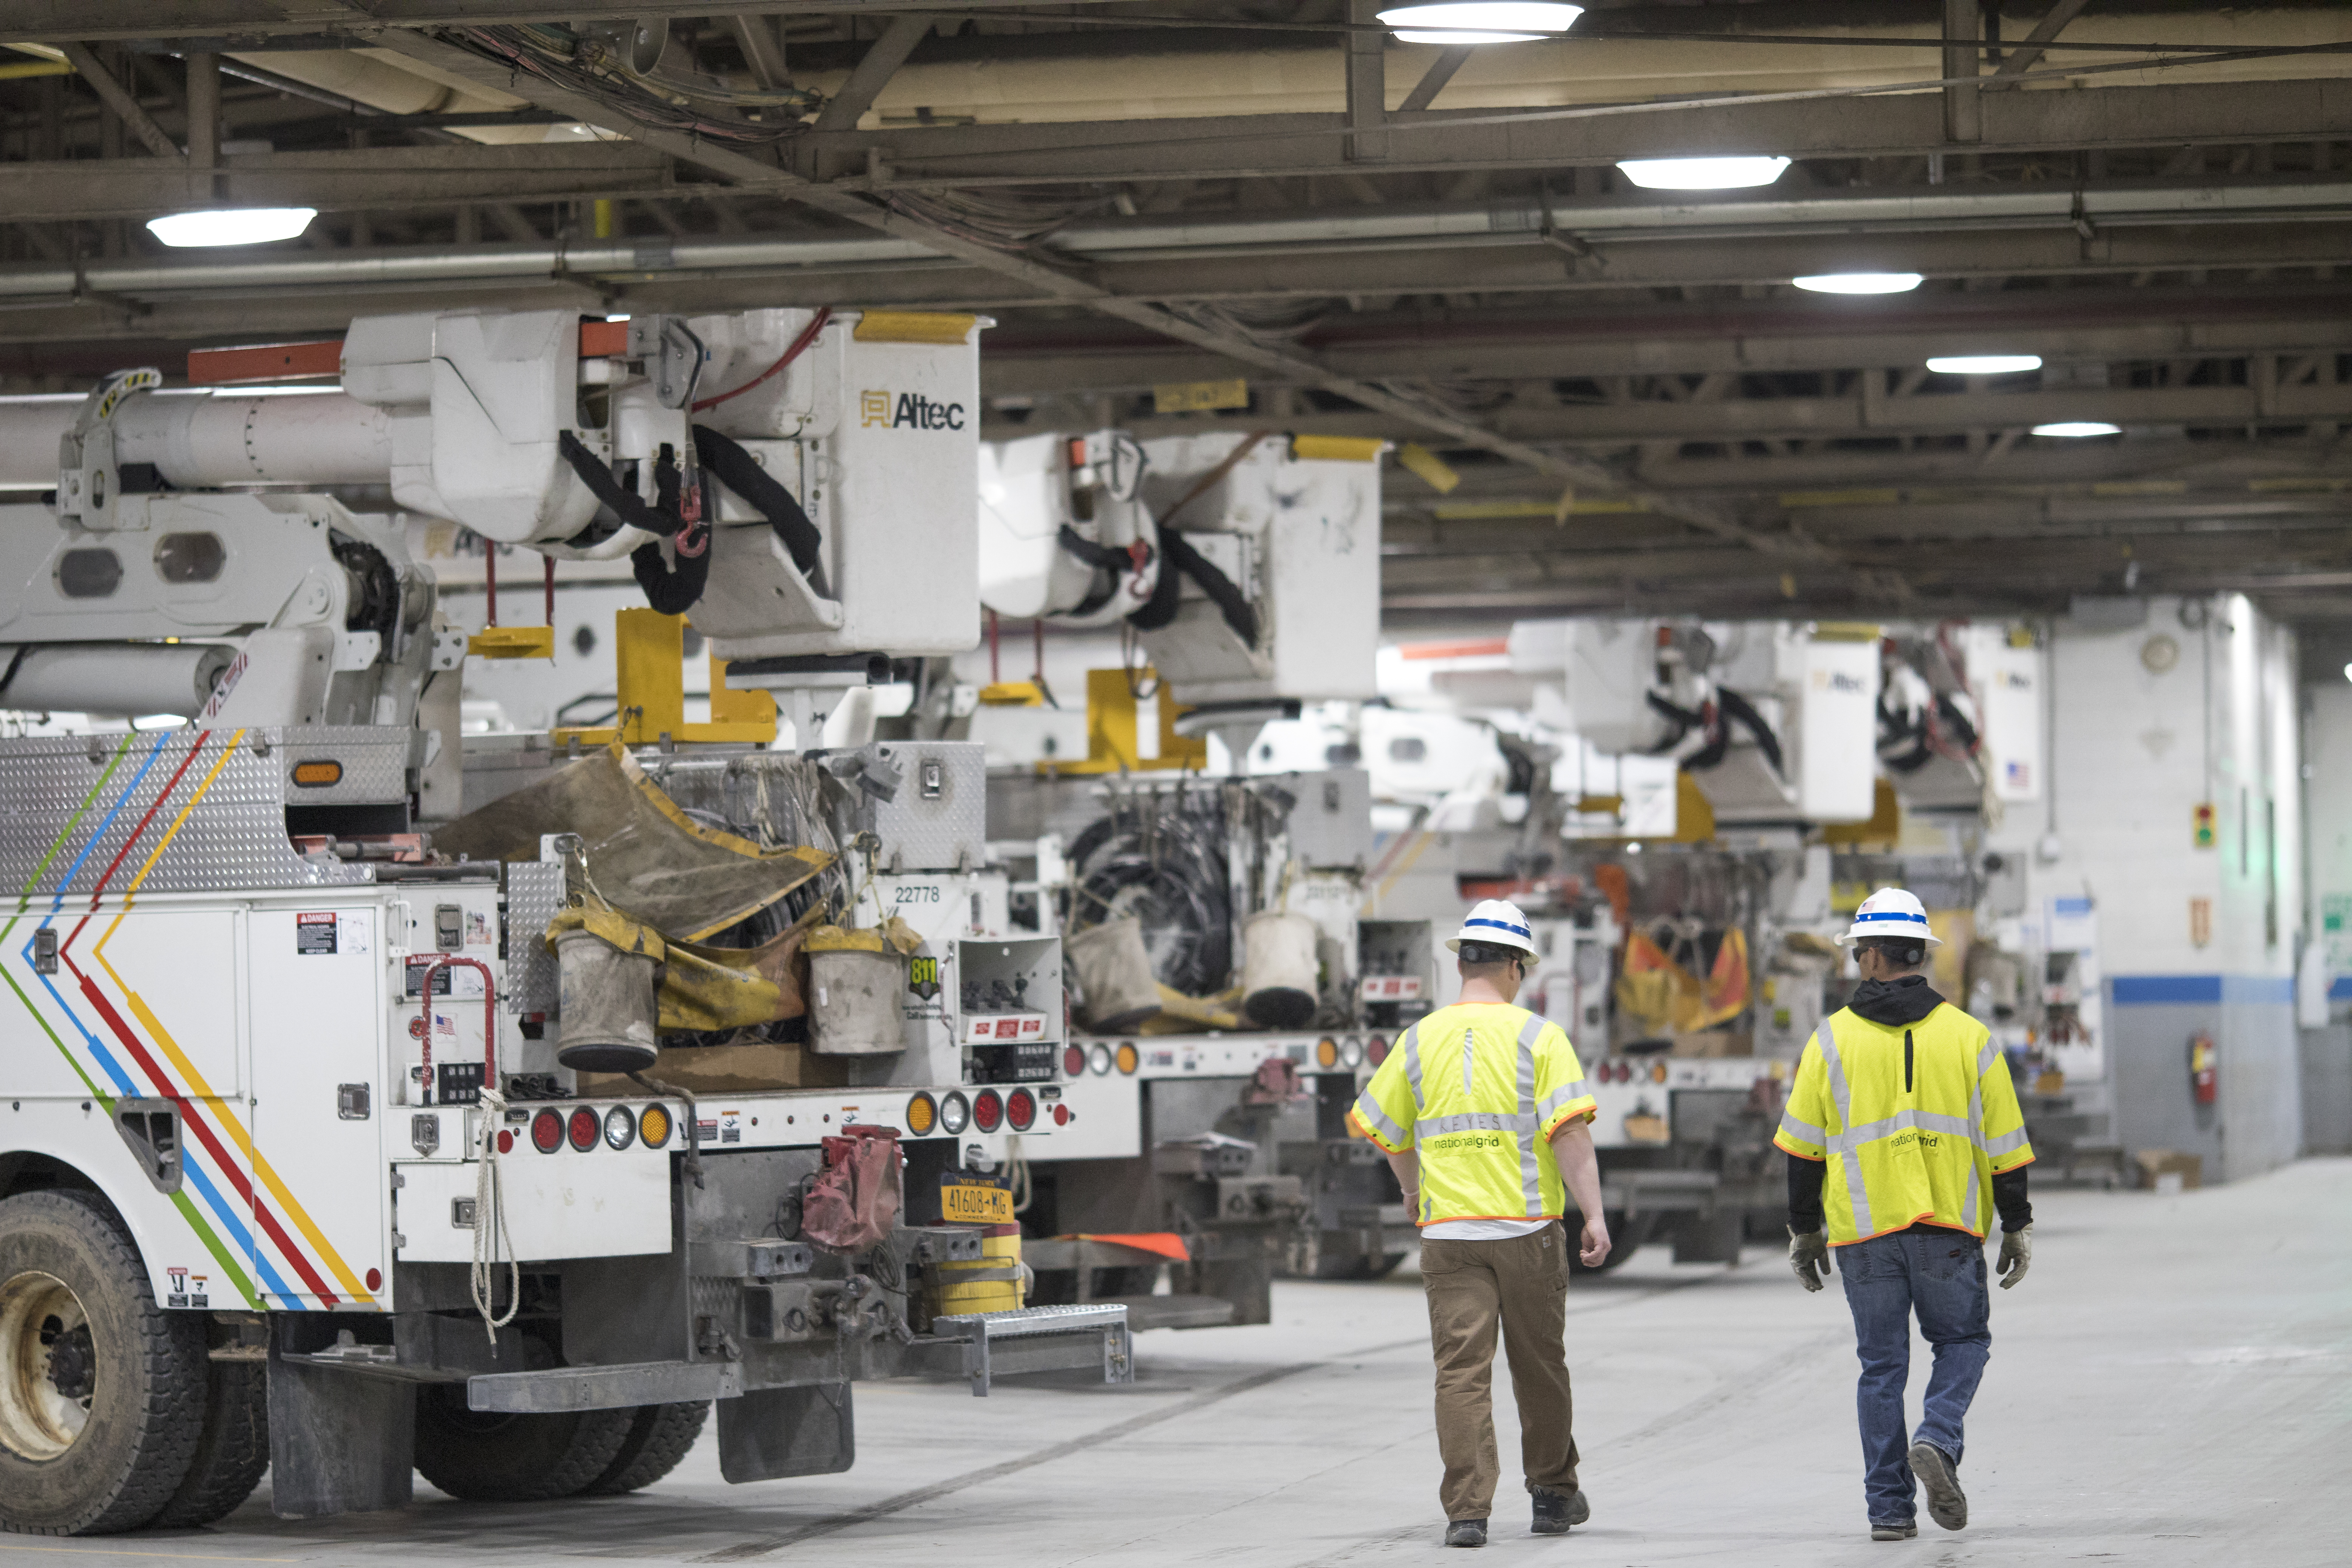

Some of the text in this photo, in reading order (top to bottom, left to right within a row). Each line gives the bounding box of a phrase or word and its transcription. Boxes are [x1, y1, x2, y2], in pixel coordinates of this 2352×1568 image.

[892, 392, 964, 431] Altec
[896, 886, 939, 903] 22778
[307, 913, 333, 922] DANGER
[911, 958, 936, 984] 811
[1440, 1114, 1501, 1134] KEYES
[1434, 1135, 1499, 1149] nationalgrid
[1890, 1133, 1937, 1149] nationrid
